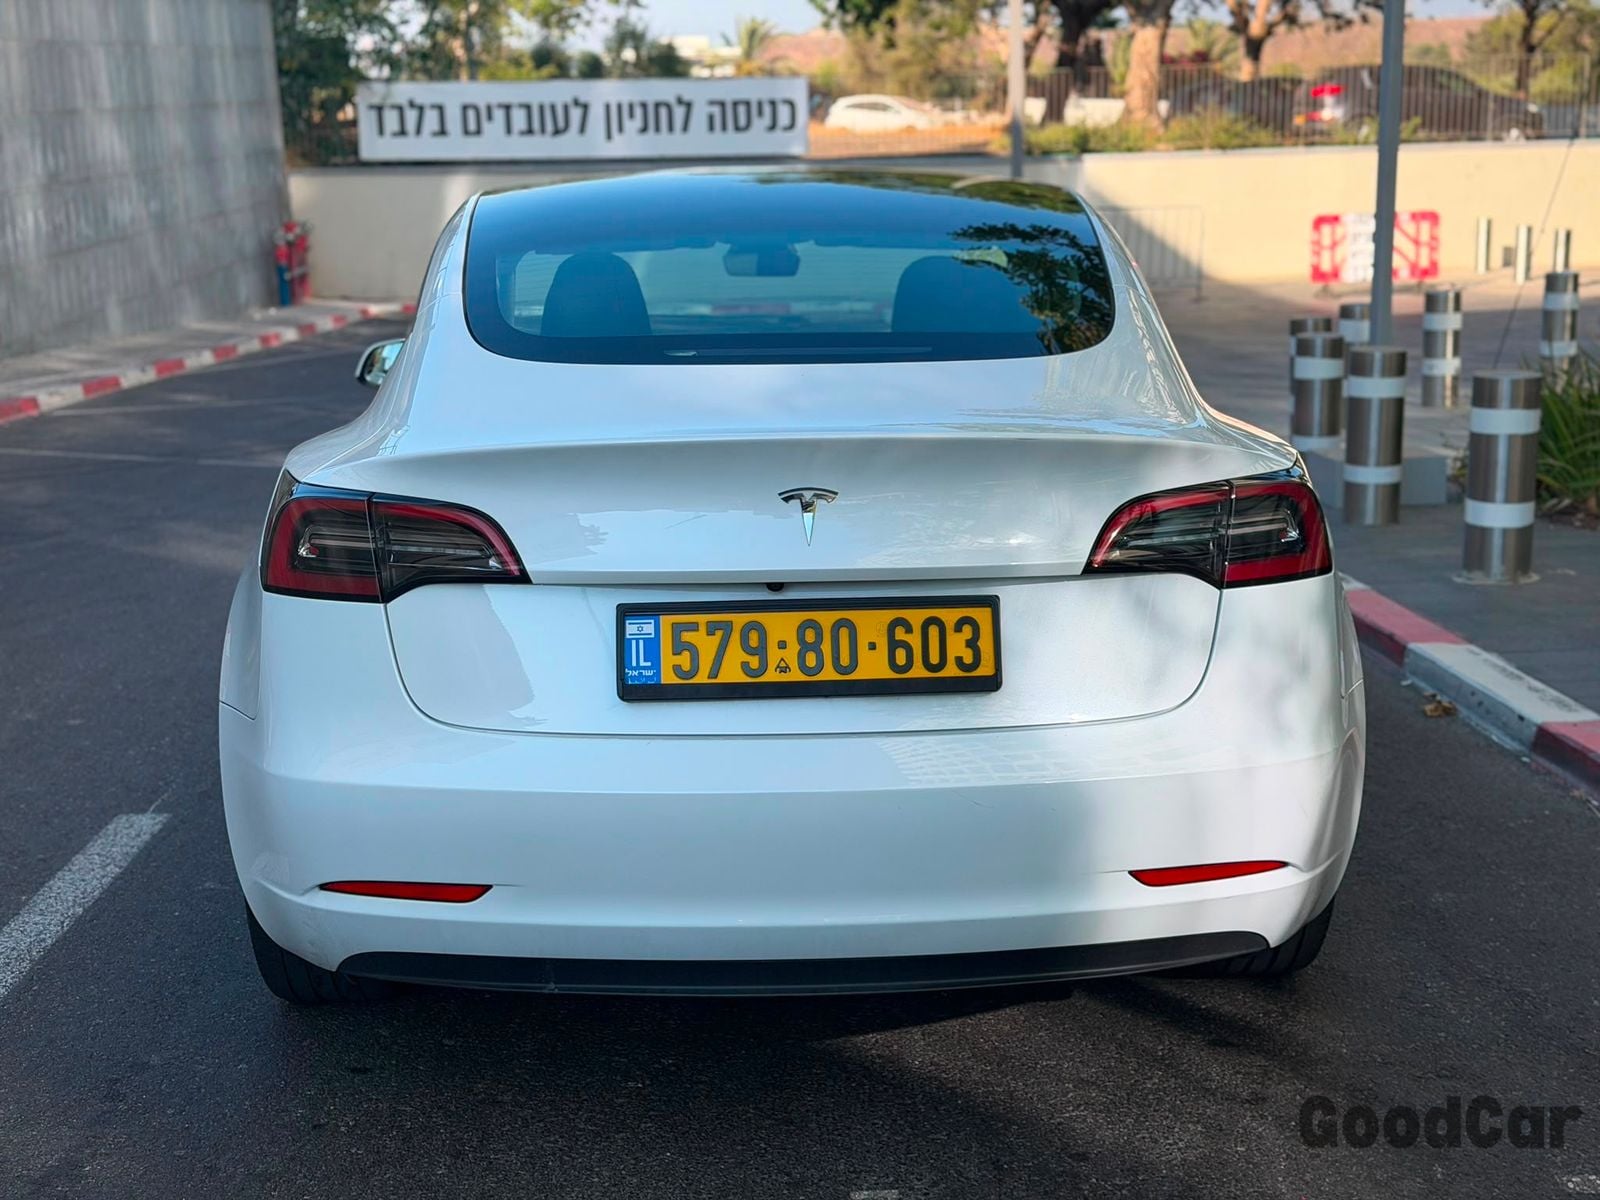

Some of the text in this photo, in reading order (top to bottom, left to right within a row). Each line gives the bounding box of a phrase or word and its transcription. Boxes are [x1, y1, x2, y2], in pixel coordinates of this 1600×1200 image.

[366, 95, 797, 141] כניסה לחניון לעובדים בלבד
[631, 639, 651, 667] IL
[625, 667, 657, 677] ישראל
